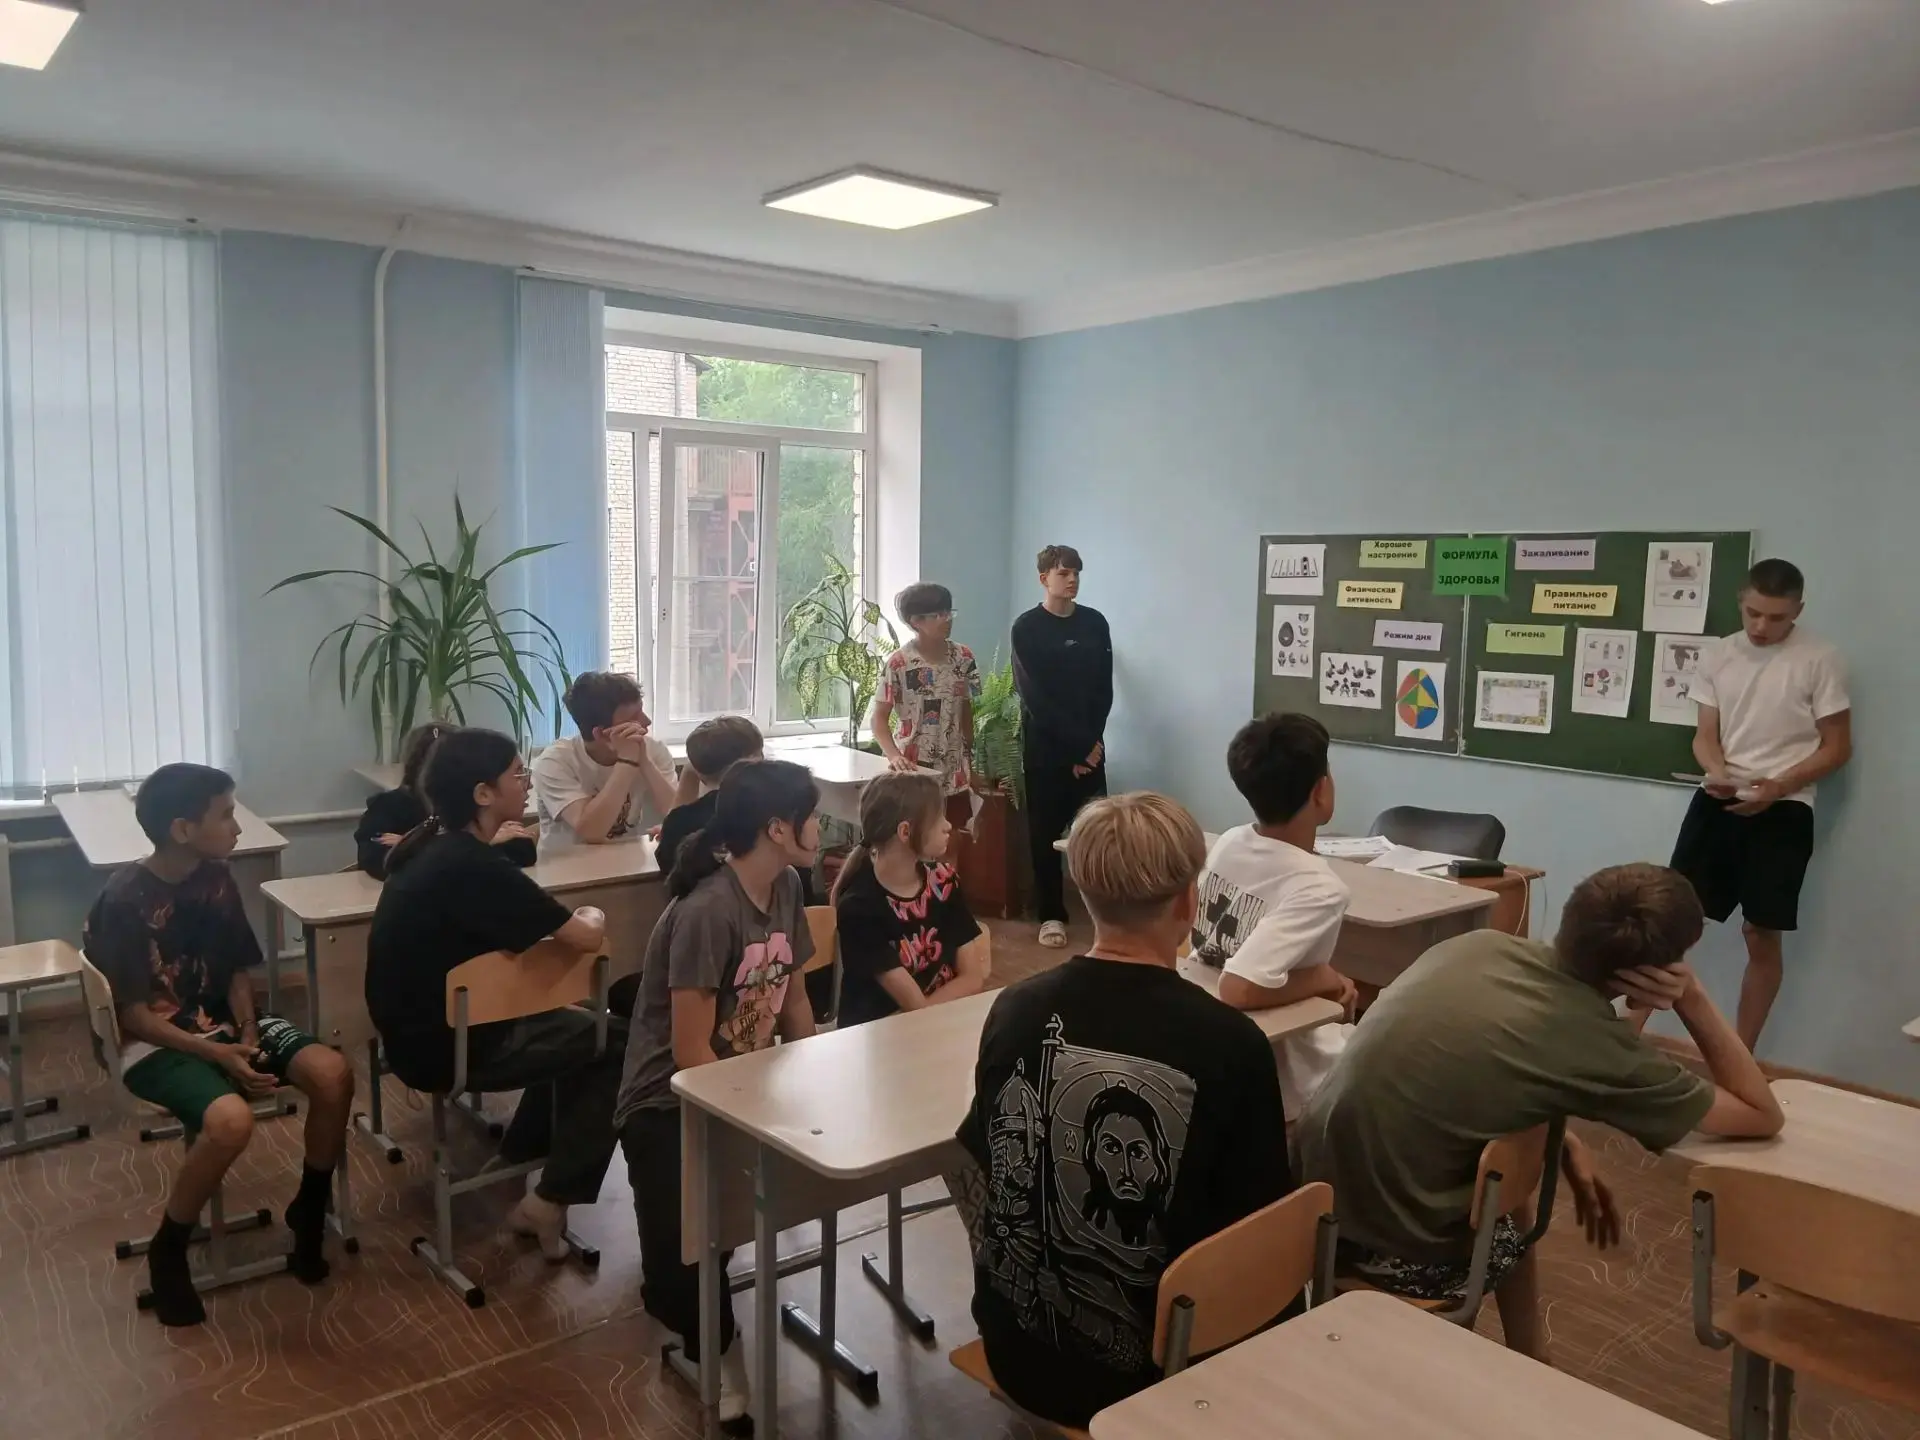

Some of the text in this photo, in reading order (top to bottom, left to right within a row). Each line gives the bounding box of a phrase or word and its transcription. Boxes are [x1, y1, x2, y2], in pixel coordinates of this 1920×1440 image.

[1374, 541, 1412, 549] Хорошее
[1367, 551, 1418, 559] настроение
[1441, 550, 1499, 561] ФОРМУЛА
[1521, 549, 1590, 558] Закаливание
[1438, 575, 1500, 586] ЗДОРОВЬЯ
[1345, 586, 1396, 594] Физическая
[1544, 589, 1608, 600] Правильное
[1553, 602, 1597, 611] питание
[1384, 631, 1432, 641] Режим дня
[1504, 629, 1546, 639] Гигиена
